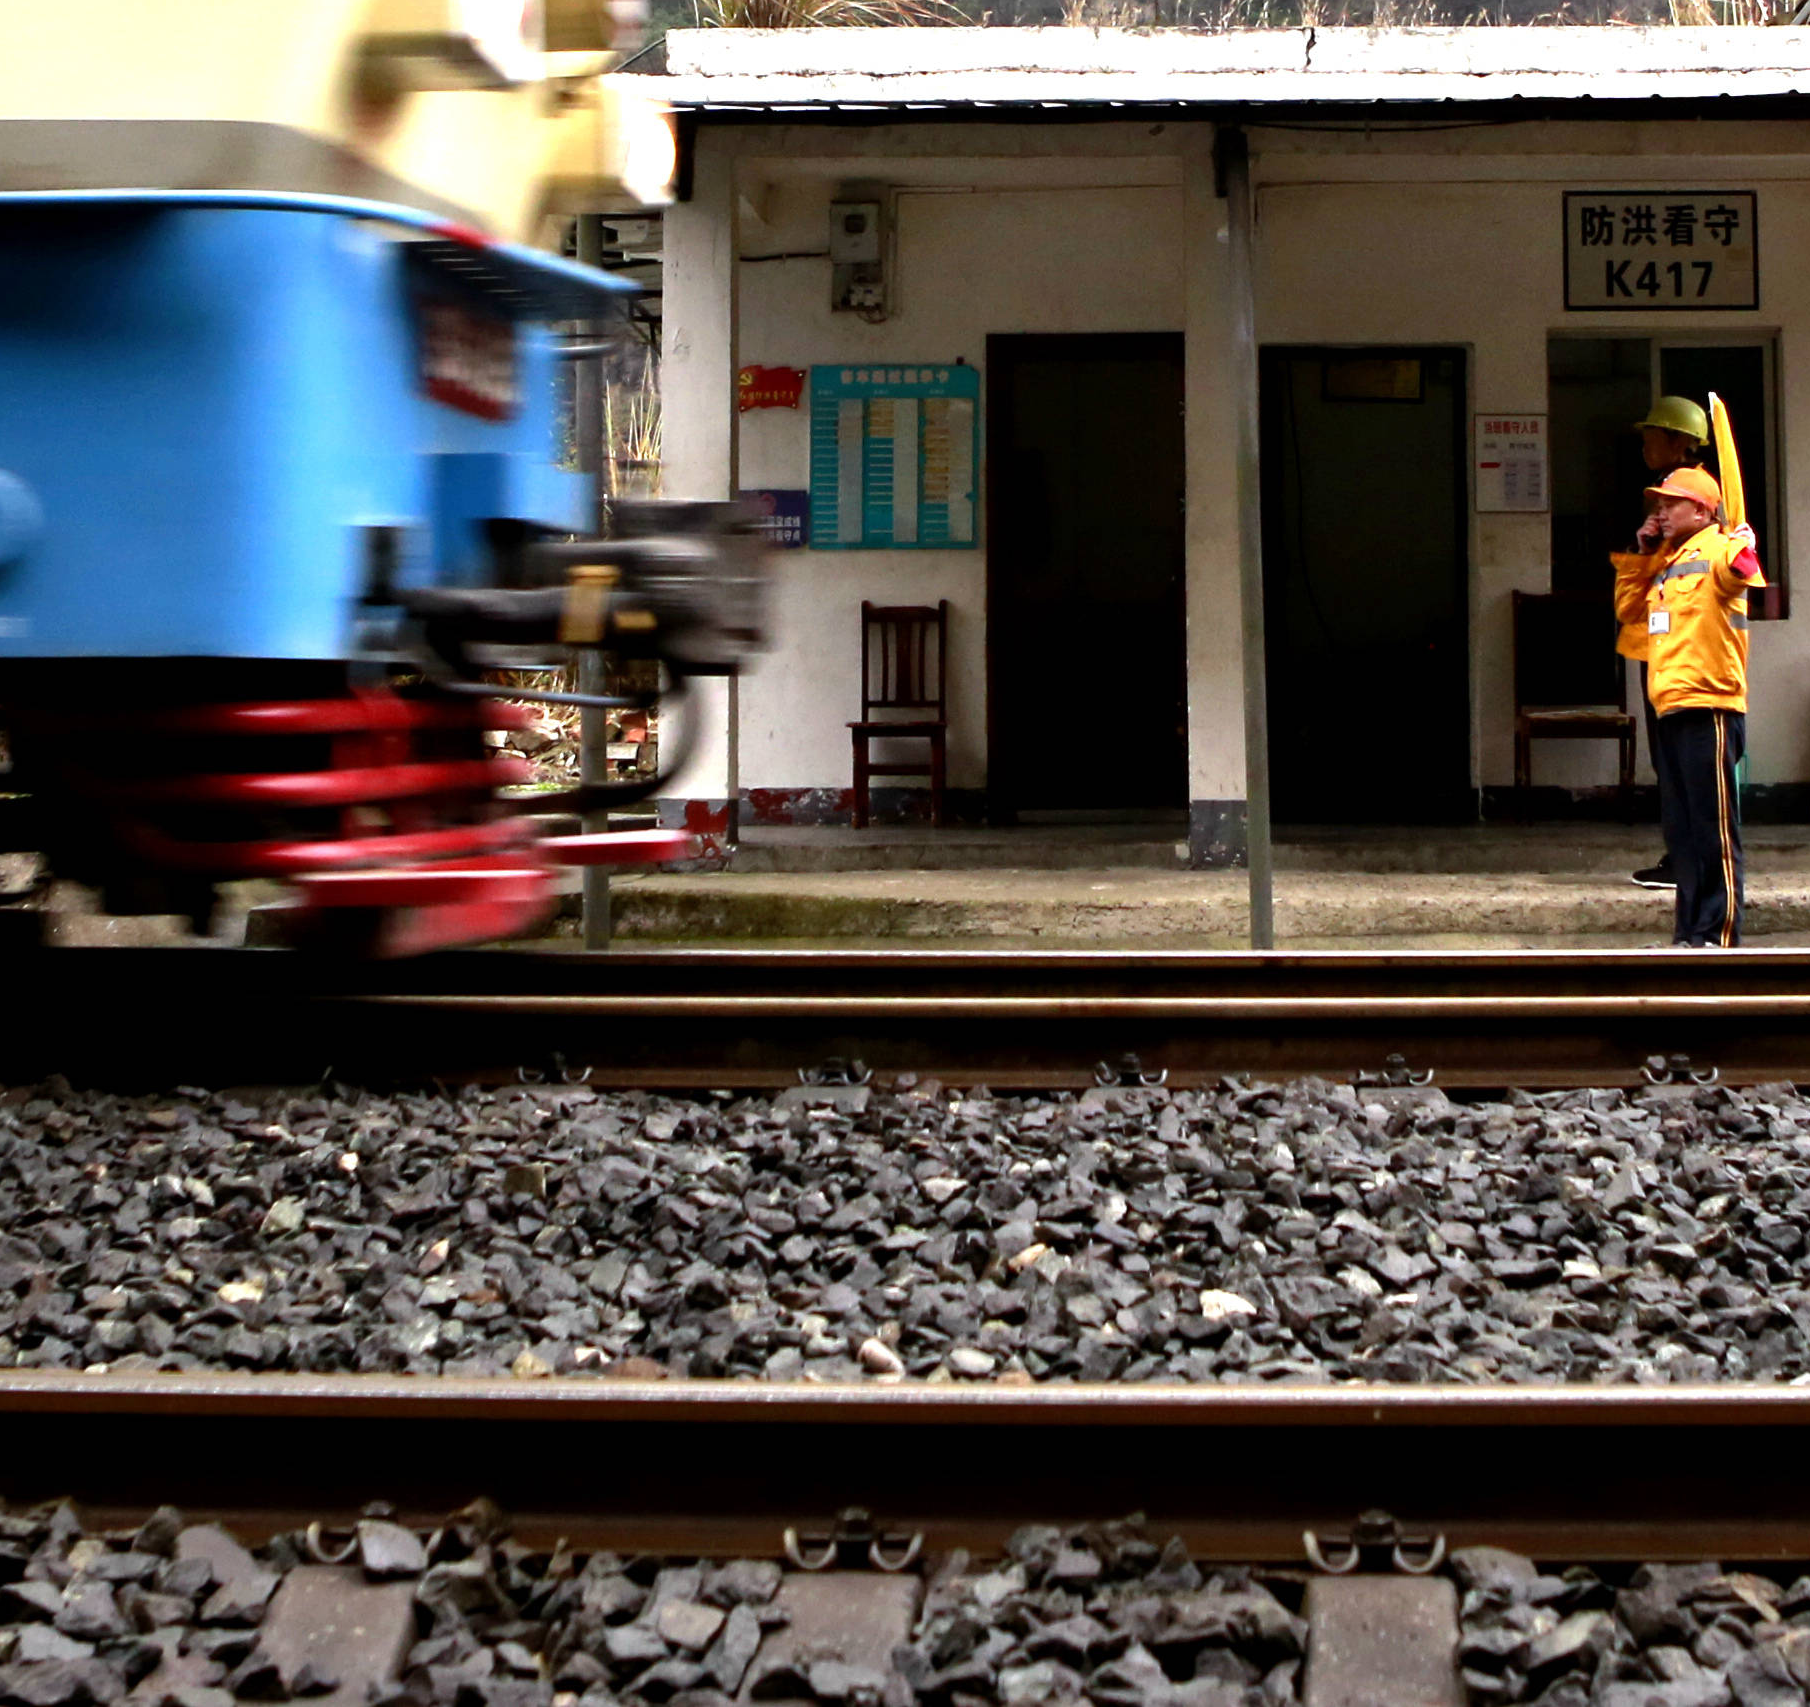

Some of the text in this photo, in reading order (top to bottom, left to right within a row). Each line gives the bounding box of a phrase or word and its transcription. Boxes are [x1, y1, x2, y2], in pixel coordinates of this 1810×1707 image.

[1581, 204, 1739, 246] 防洪看守
[1606, 260, 1713, 297] K417
